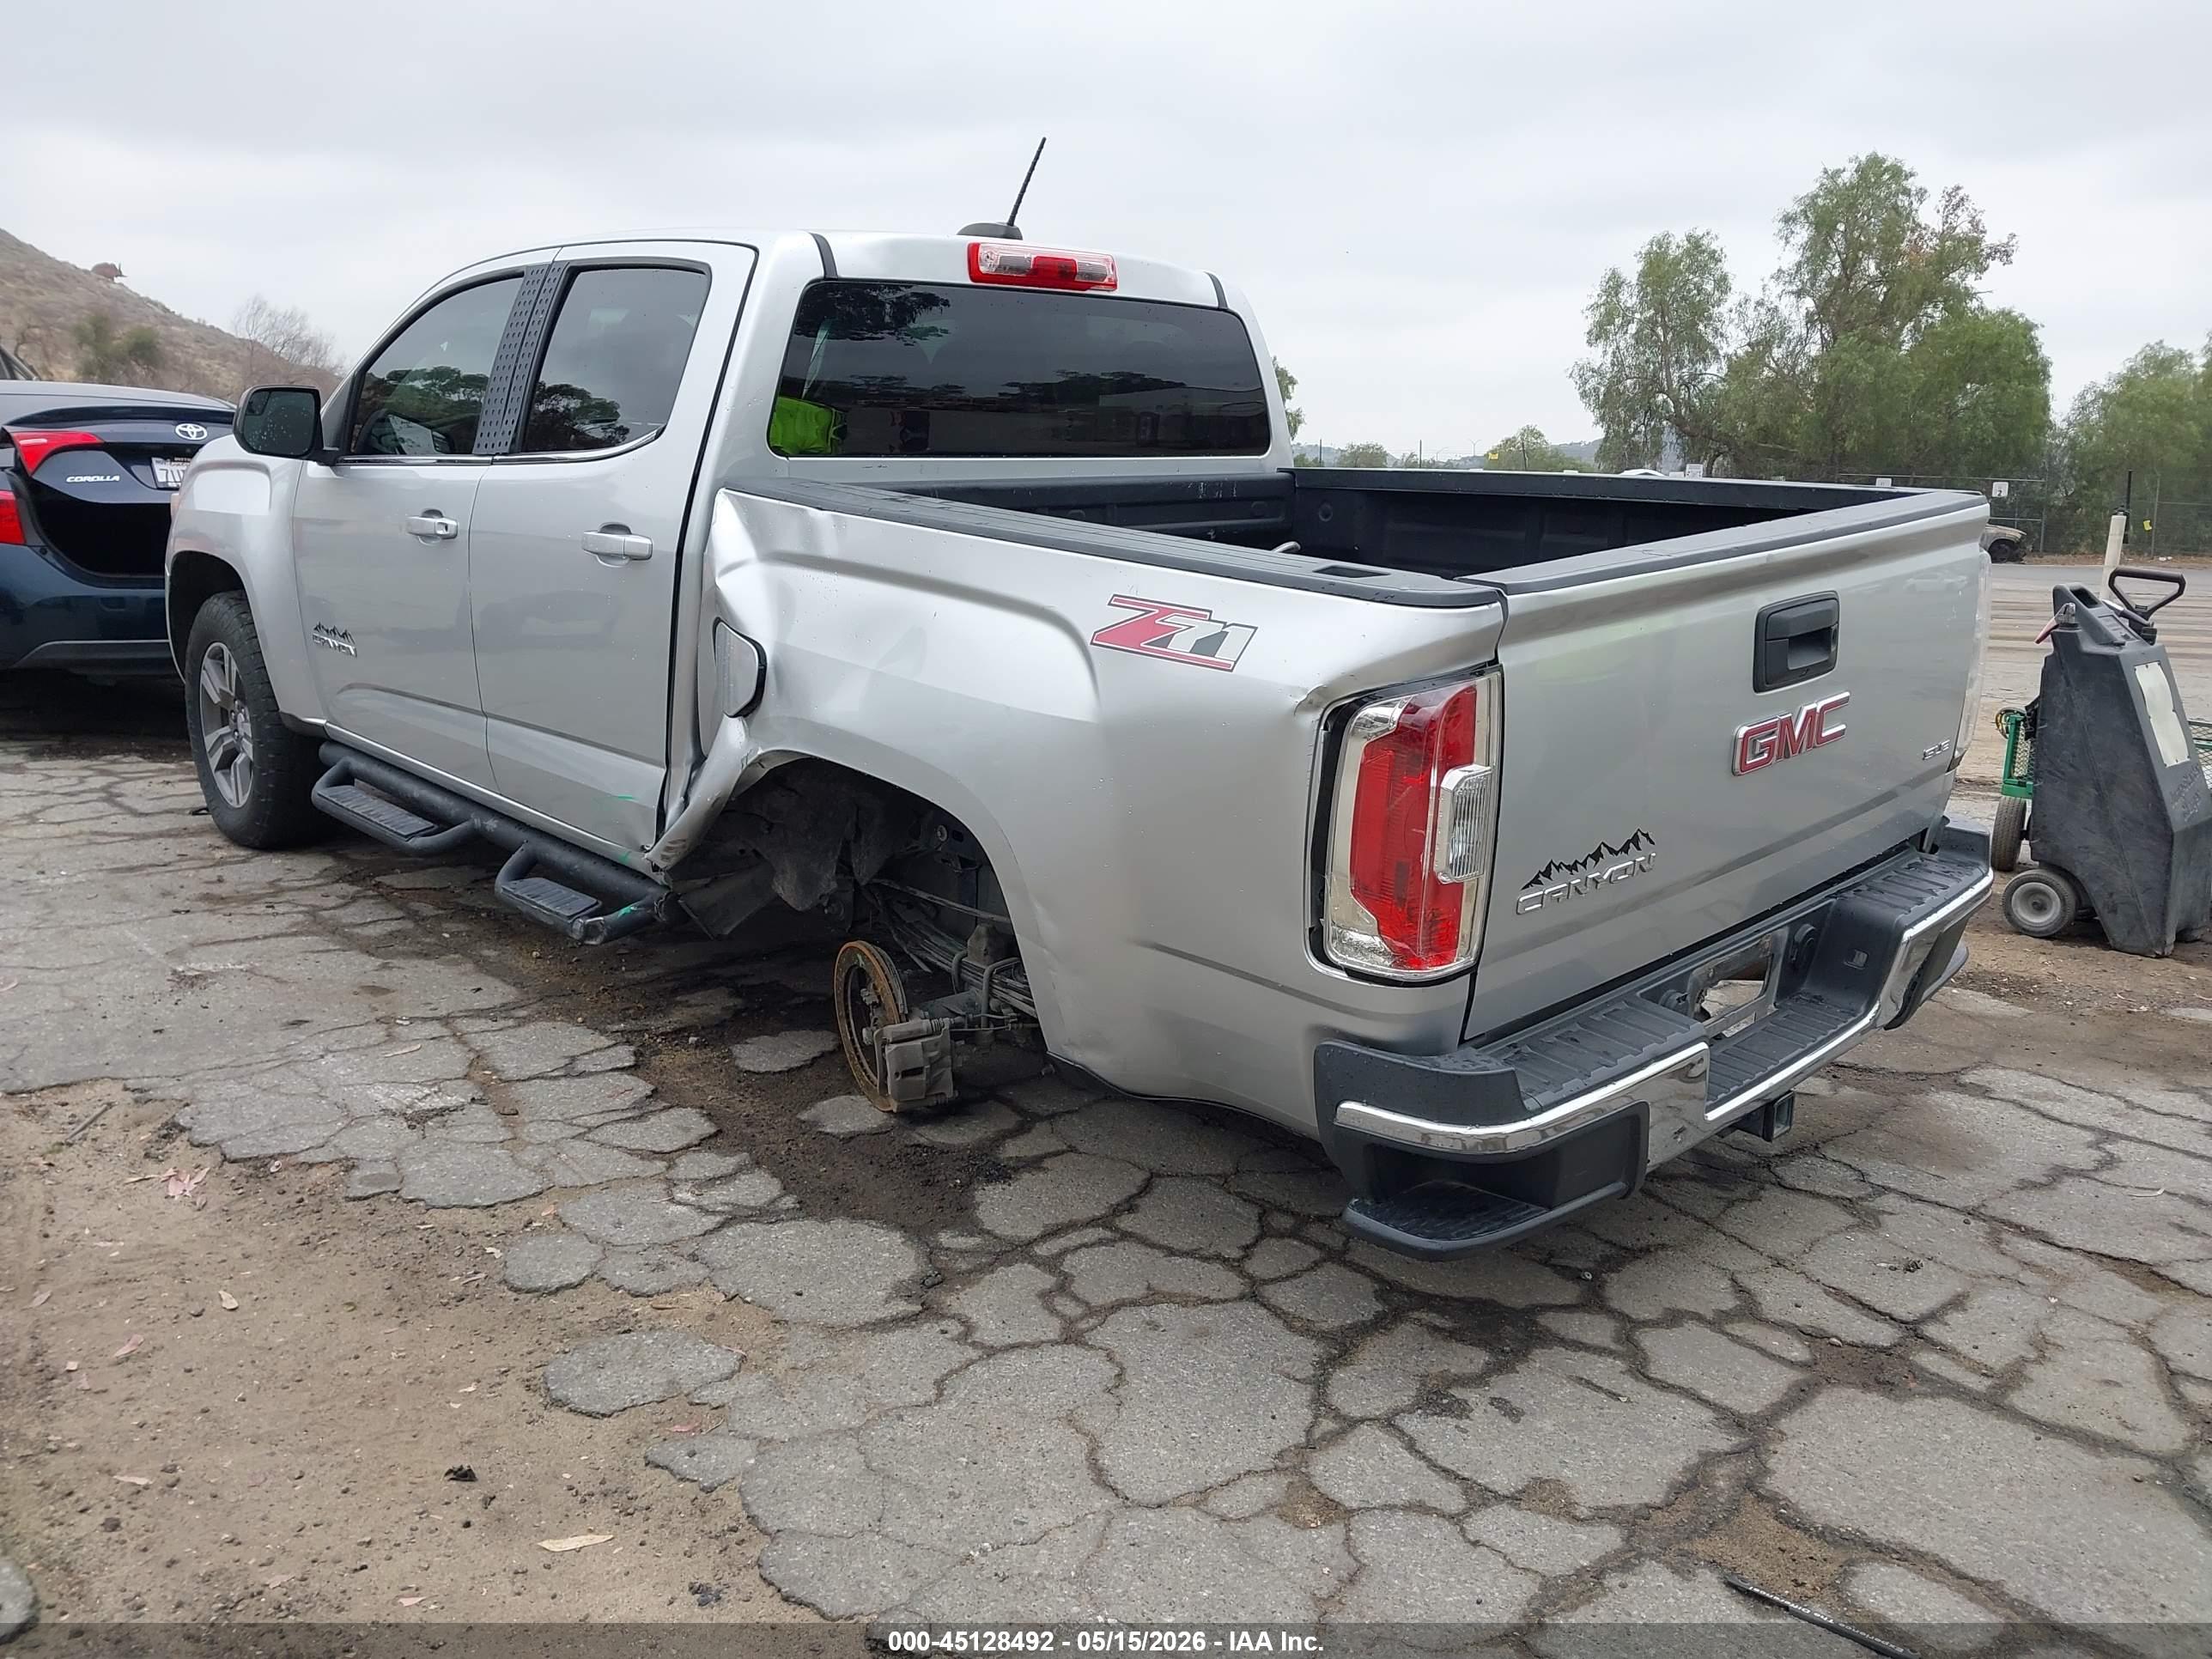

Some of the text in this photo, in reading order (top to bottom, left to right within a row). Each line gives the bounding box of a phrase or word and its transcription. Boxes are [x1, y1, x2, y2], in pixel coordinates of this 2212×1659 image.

[1091, 593, 1258, 672] Z71
[1732, 691, 1850, 776] GMC
[1923, 739, 1950, 760] SLE
[1516, 853, 1656, 915] CANYON
